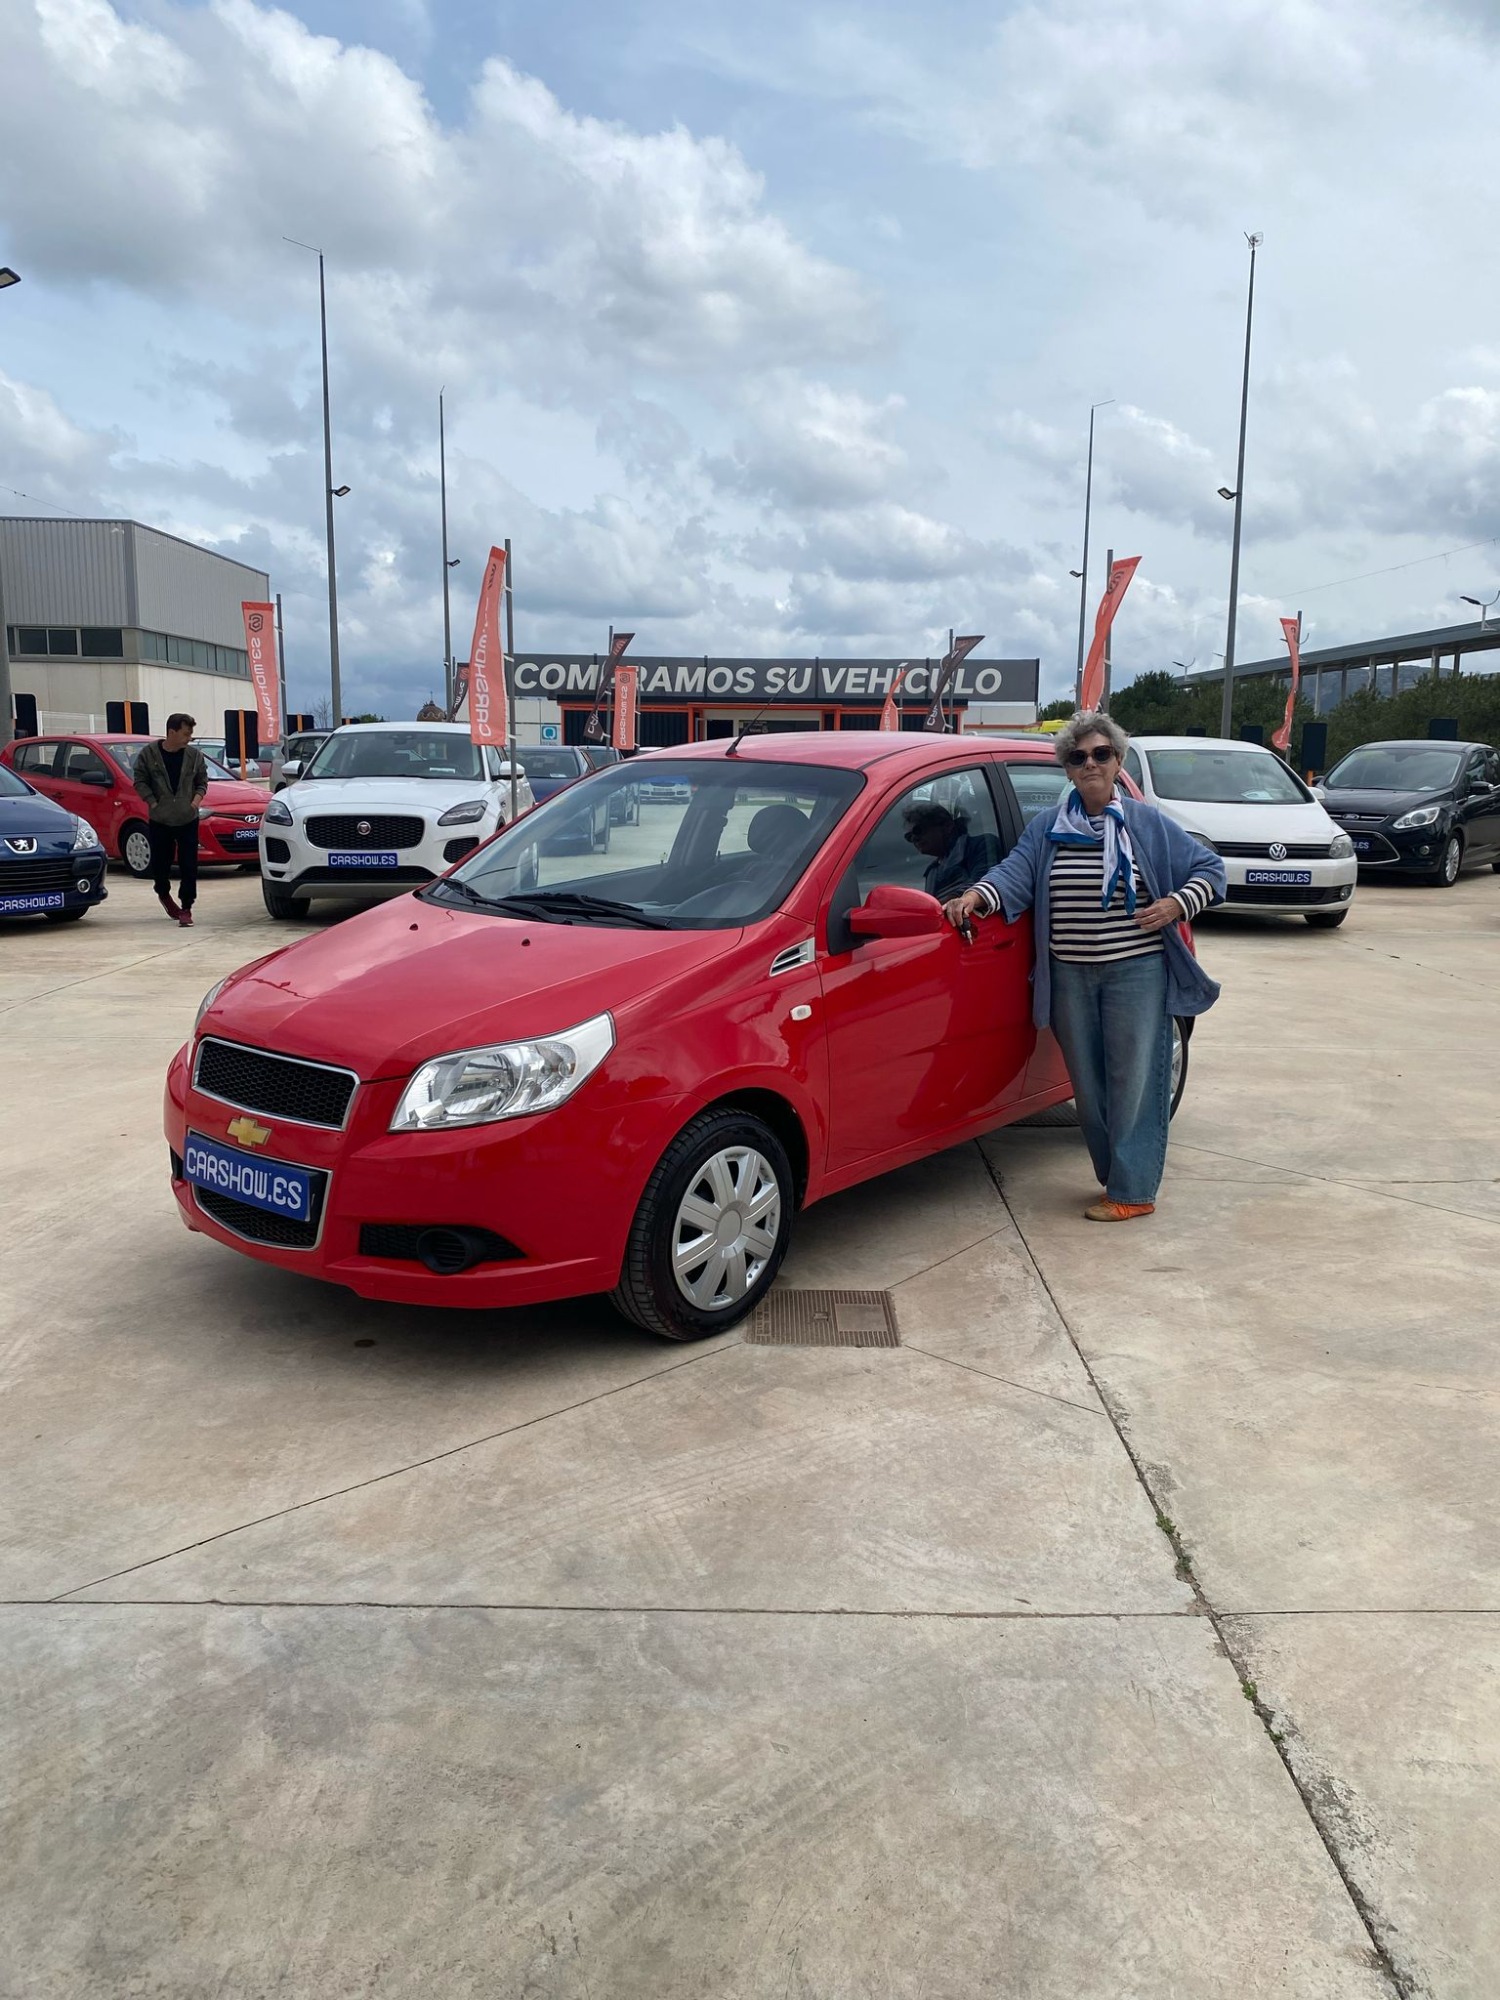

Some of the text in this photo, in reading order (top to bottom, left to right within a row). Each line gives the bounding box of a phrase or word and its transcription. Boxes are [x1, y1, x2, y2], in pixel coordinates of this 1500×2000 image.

[514, 663, 756, 694] COMRAMOS
[764, 667, 812, 694] SU
[330, 855, 396, 865] CARSHOW.ES
[1248, 872, 1310, 883] CARSHOW.ES
[0, 895, 61, 911] CARSHOW.ES
[186, 1147, 303, 1210] CARSHOW.ES
